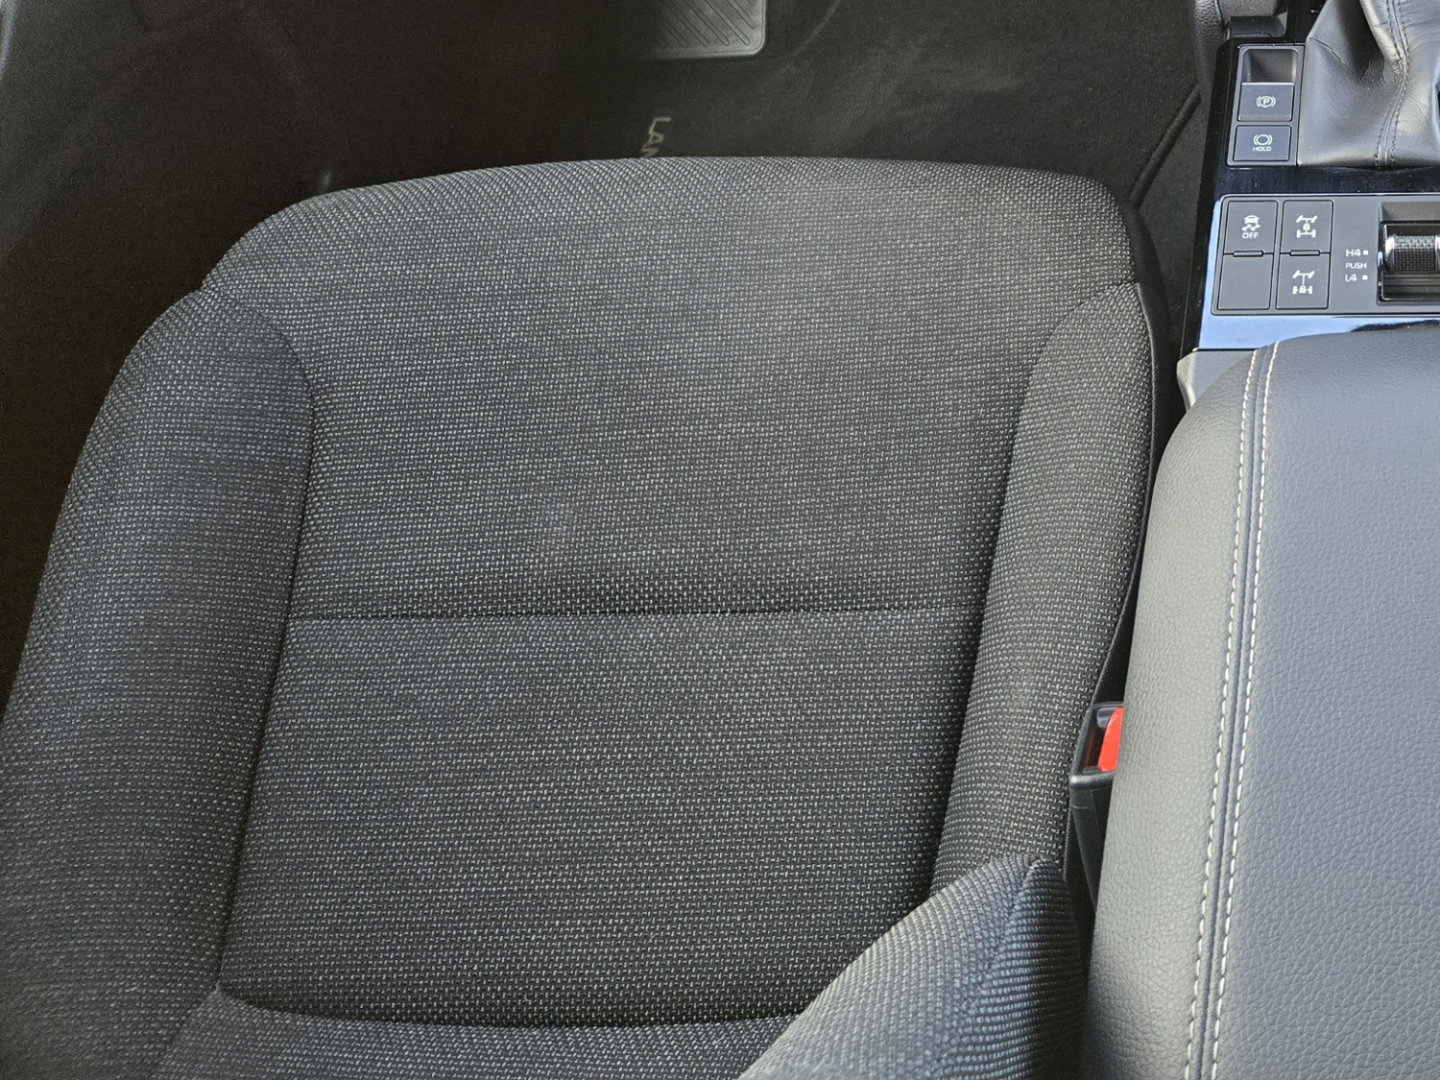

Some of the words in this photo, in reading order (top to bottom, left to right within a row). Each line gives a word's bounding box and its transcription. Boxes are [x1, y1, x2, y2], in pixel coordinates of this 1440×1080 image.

[1241, 231, 1258, 239] OFF
[1345, 248, 1361, 257] H4
[1344, 273, 1357, 282] L4
